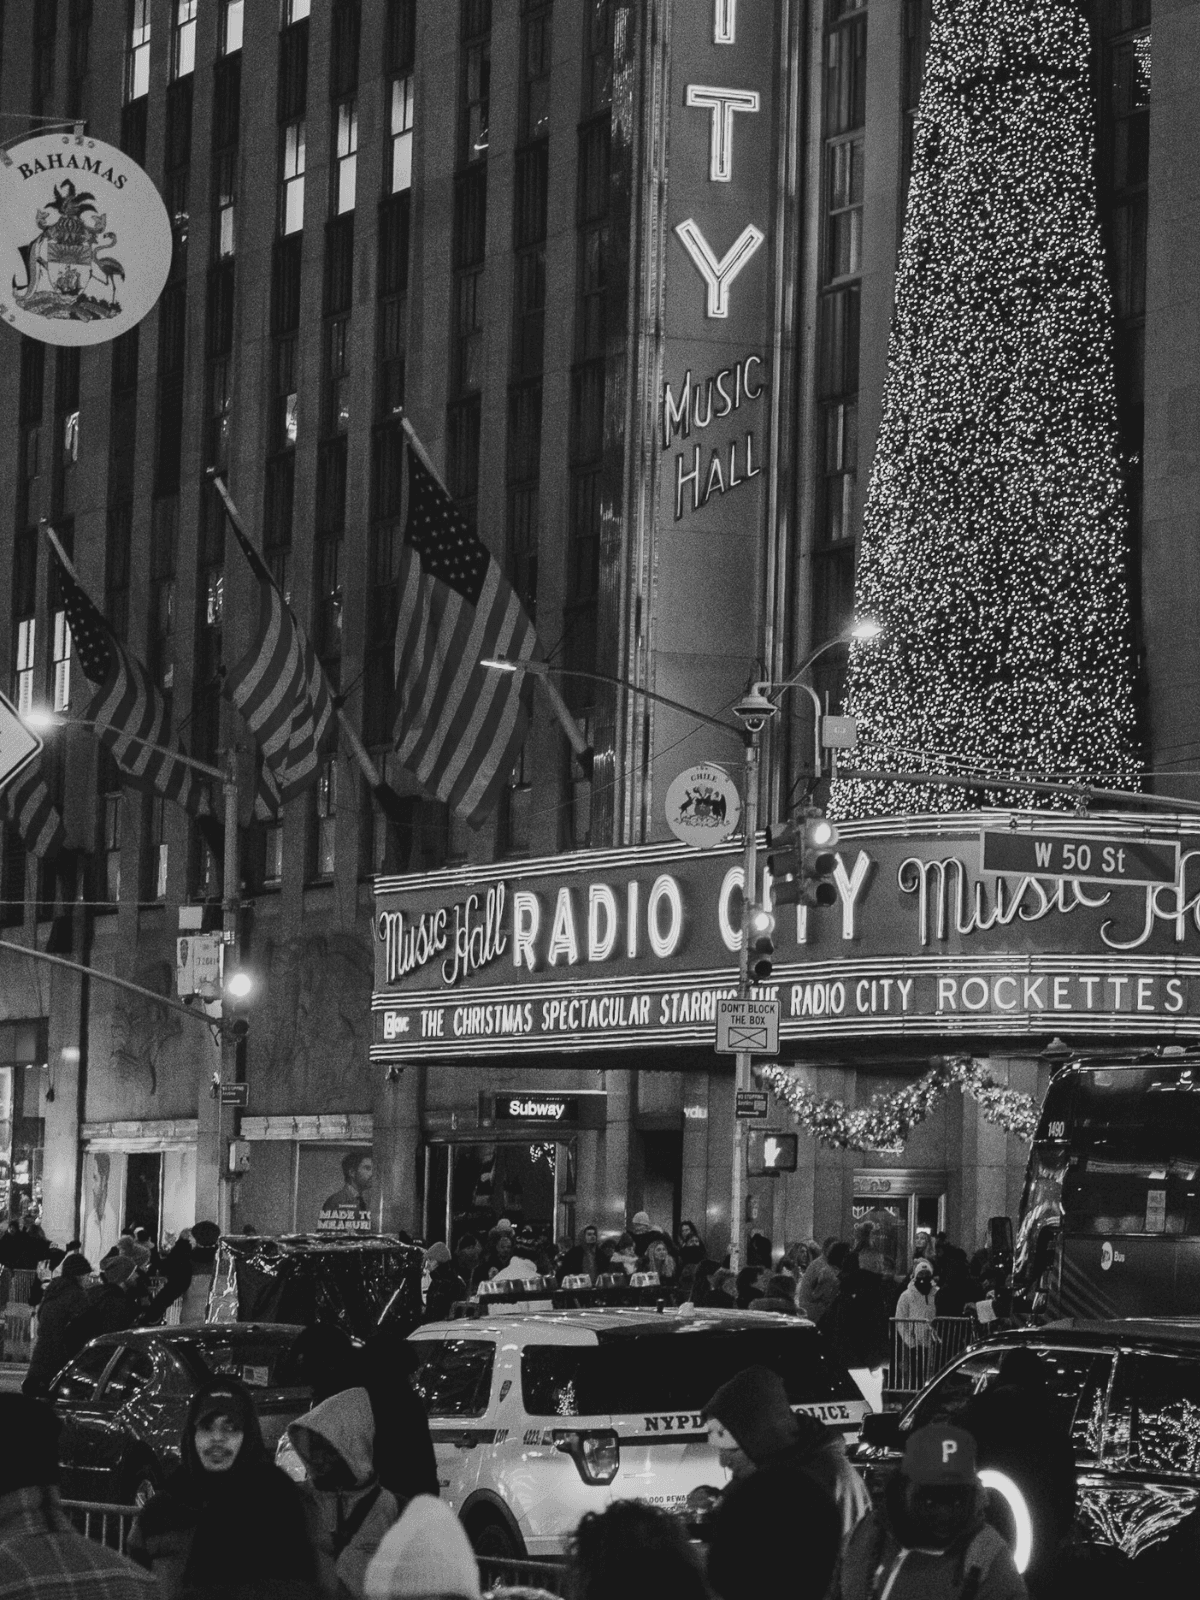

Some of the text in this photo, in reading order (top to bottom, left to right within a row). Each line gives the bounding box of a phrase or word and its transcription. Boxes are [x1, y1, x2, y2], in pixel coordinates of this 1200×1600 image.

[17, 153, 128, 190] BAHAMAS
[664, 355, 762, 447] MUSIC
[676, 435, 761, 517] HALL
[690, 773, 717, 783] CHILE
[1034, 842, 1125, 873] W 50 St
[378, 908, 447, 984] Music
[442, 880, 506, 984] Hall
[513, 873, 683, 972] RADIO
[721, 1003, 775, 1014] DON'T BLOCK
[790, 982, 846, 1016] RADIO
[856, 978, 913, 1012] CITY
[938, 976, 1184, 1012] ROCKETTES
[421, 1009, 445, 1037] THE
[453, 1002, 532, 1037] CHRISTMAS
[541, 995, 650, 1031] SPECTACULAR
[731, 1015, 765, 1026] THE BOX
[509, 1100, 565, 1119] Subway
[319, 1210, 355, 1220] MADE
[643, 1414, 705, 1432] NYPD
[942, 1440, 957, 1462] P
